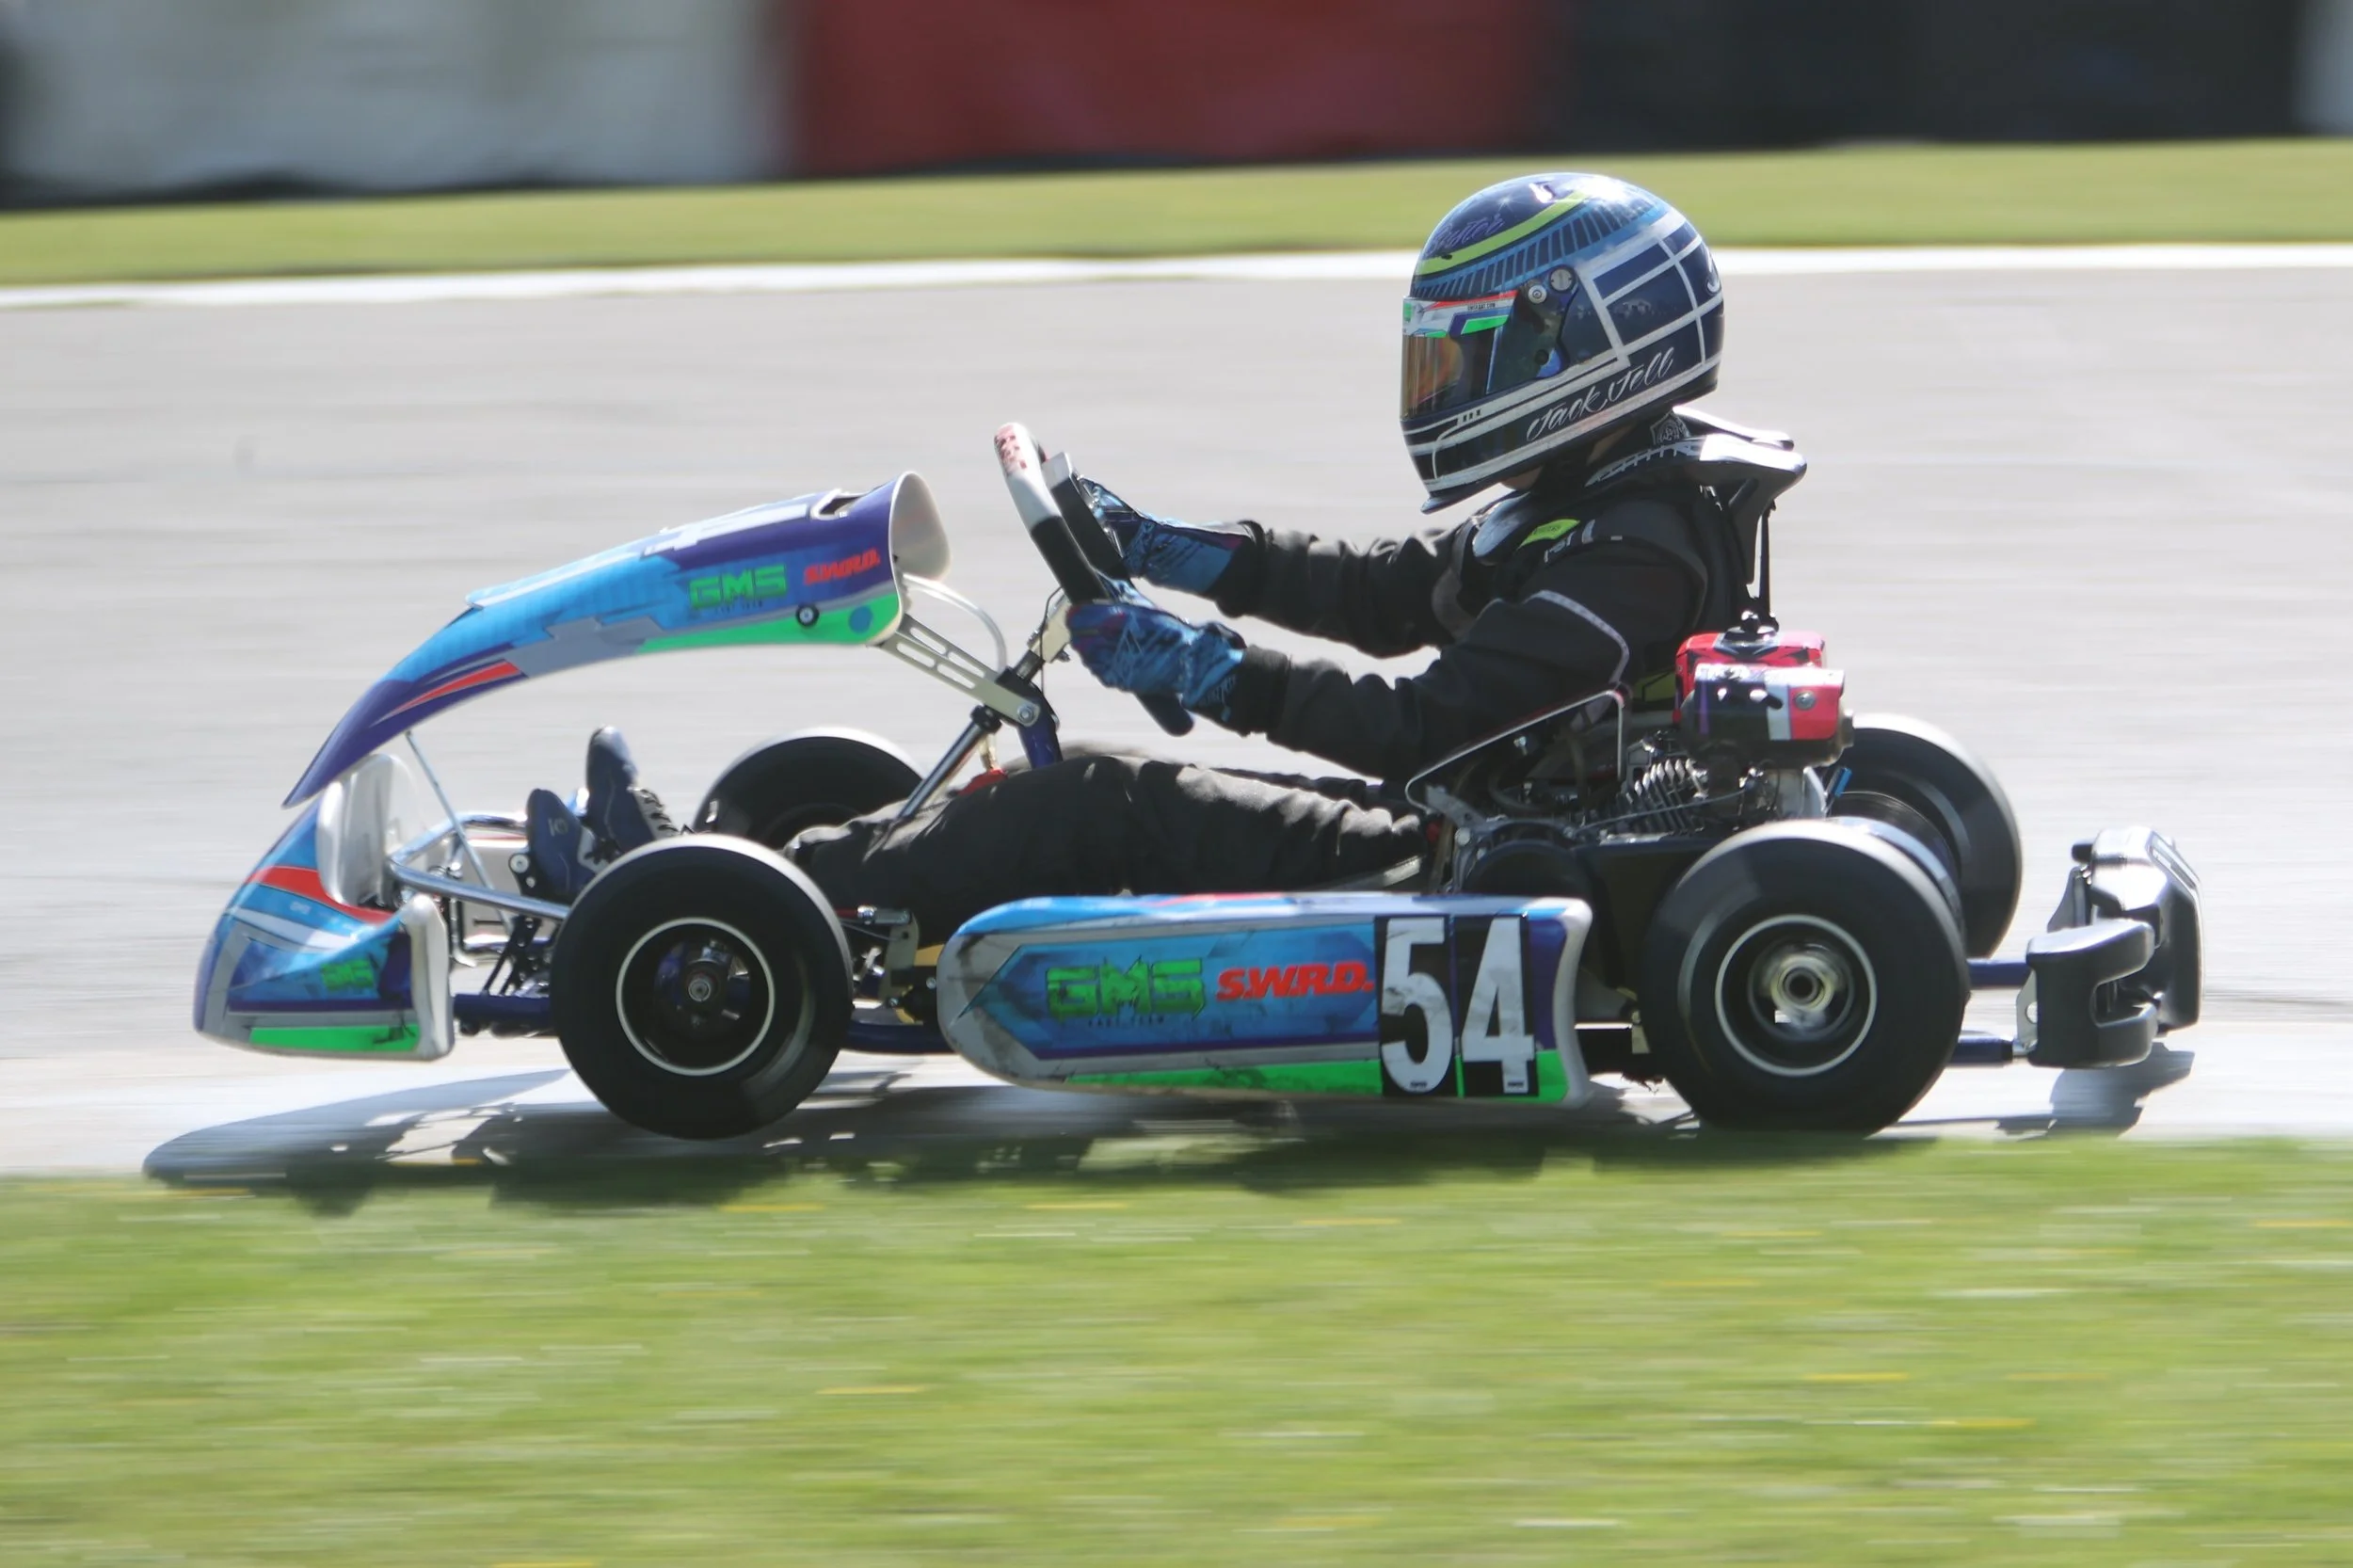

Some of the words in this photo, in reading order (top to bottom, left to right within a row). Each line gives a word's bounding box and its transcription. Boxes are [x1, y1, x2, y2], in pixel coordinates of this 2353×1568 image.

[1527, 386, 1608, 441] Jack
[690, 563, 787, 609] GMS
[1046, 956, 1205, 1020] GMS
[1216, 960, 1375, 1001] S.W.R.D.
[1382, 917, 1535, 1093] 54
